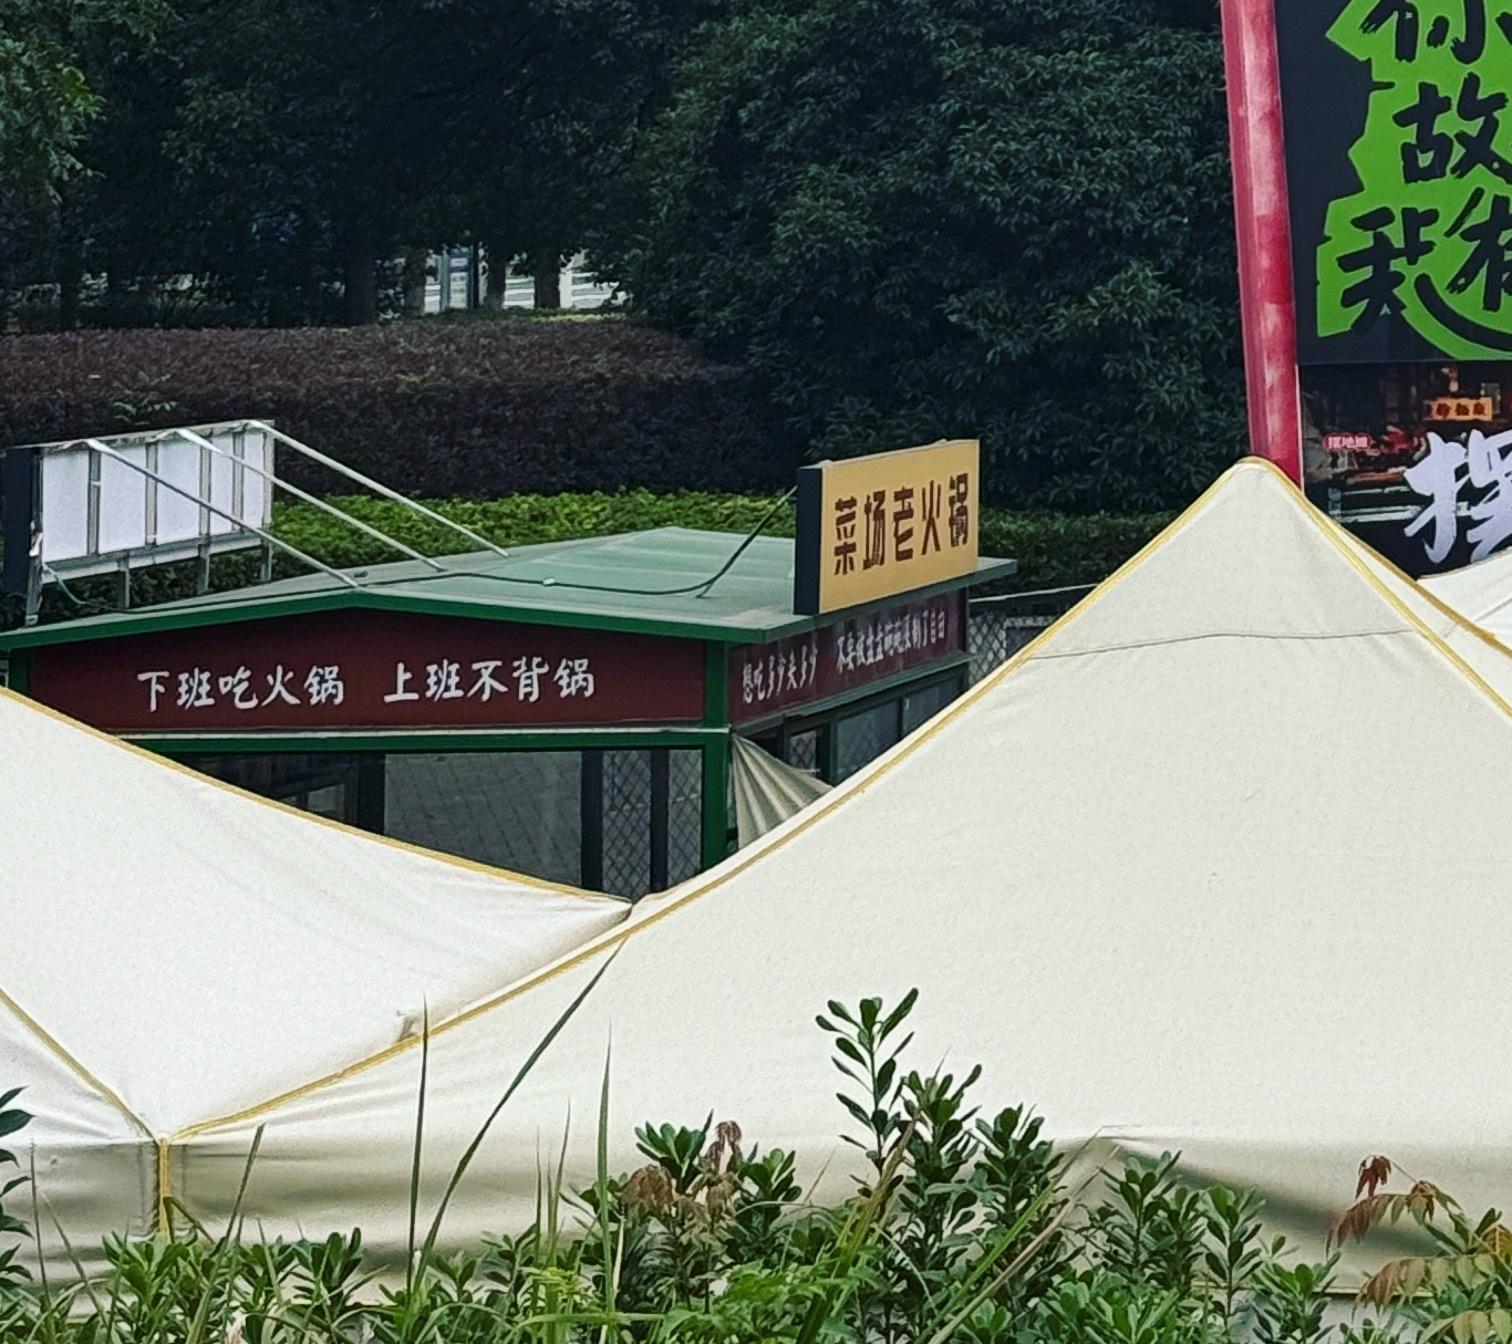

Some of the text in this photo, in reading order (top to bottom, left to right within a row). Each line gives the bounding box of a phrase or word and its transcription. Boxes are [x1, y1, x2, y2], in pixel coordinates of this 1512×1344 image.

[833, 472, 970, 576] 菜场老火锅
[137, 657, 595, 712] 下班吃火锅 上班不背锅
